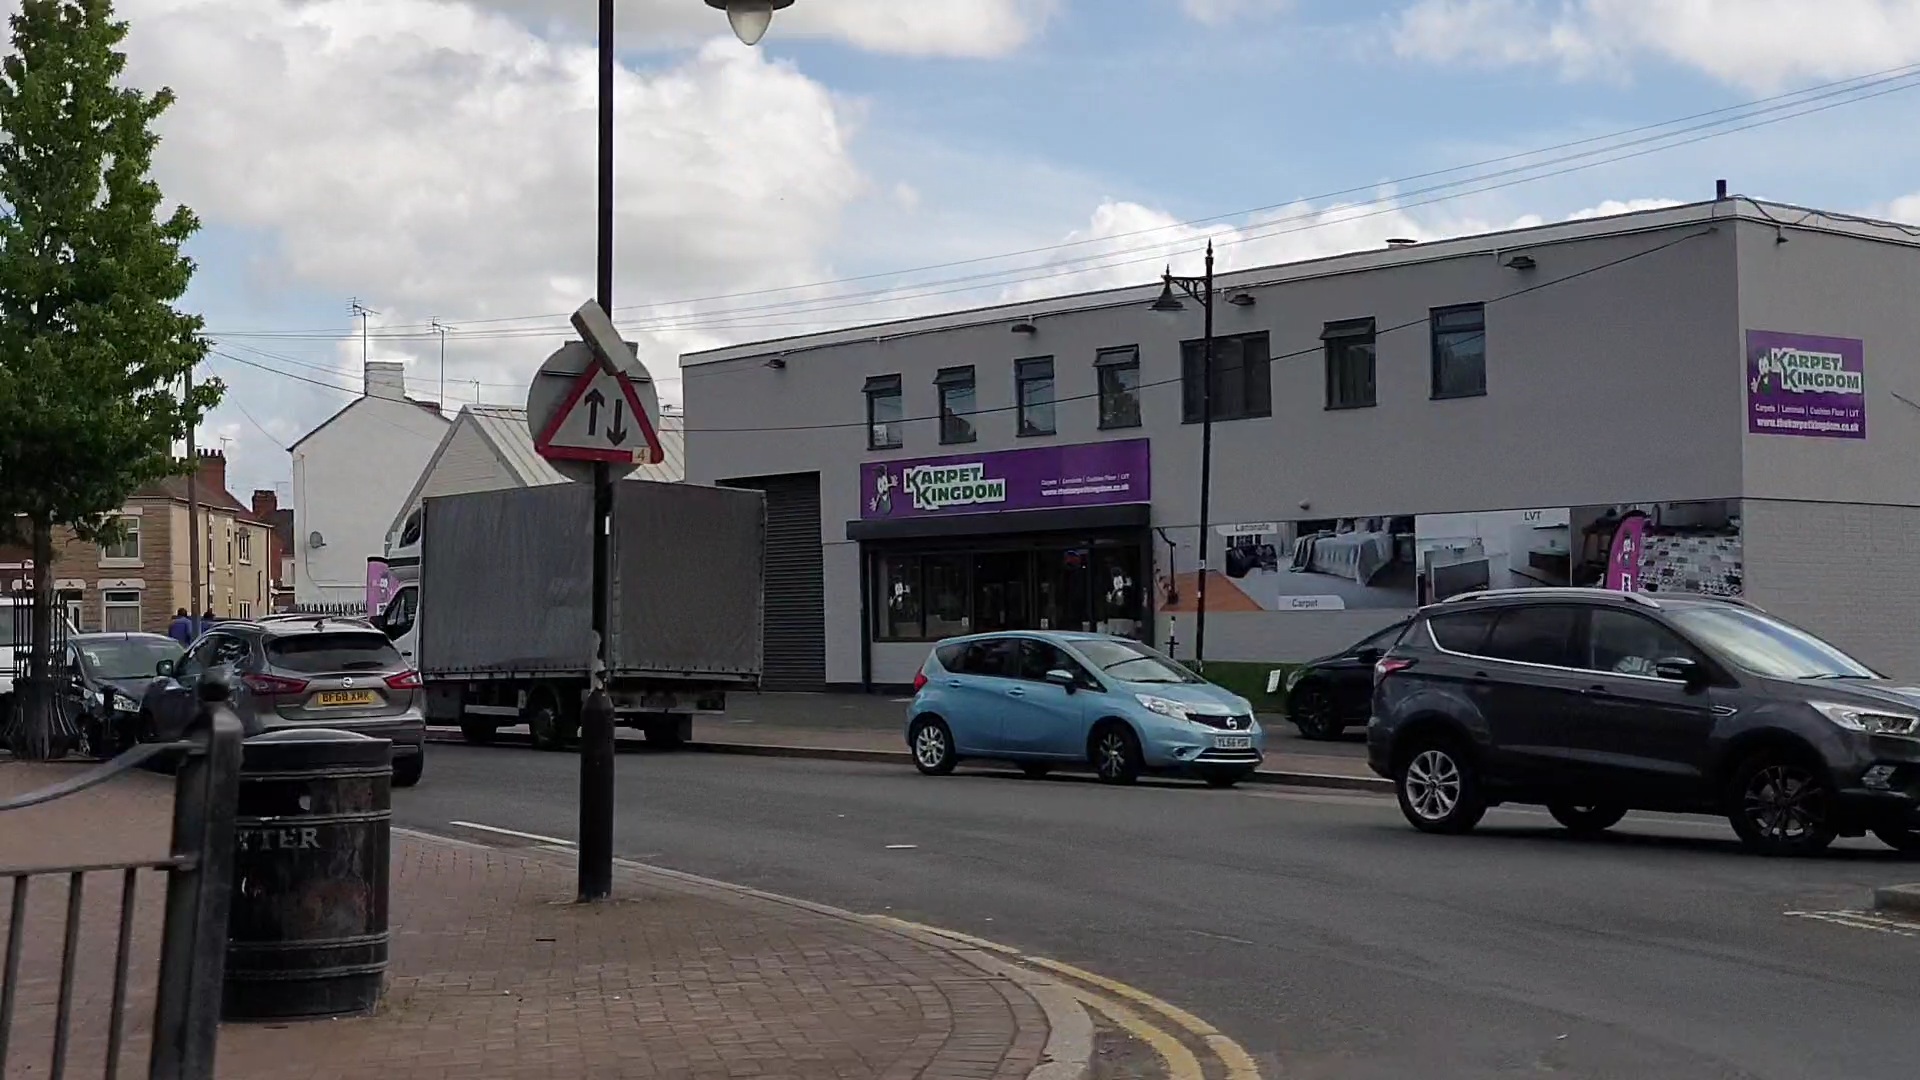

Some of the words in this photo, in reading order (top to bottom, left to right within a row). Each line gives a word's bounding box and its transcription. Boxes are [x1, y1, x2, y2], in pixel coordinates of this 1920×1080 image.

[1773, 350, 1840, 370] KARPET
[1783, 369, 1860, 389] KINGDOM
[637, 448, 645, 461] 4
[905, 467, 981, 489] KARPET
[916, 483, 1003, 506] KINGDOM
[1523, 510, 1542, 521] LVT
[1291, 598, 1318, 609] Carpet
[239, 827, 321, 850] TTER
